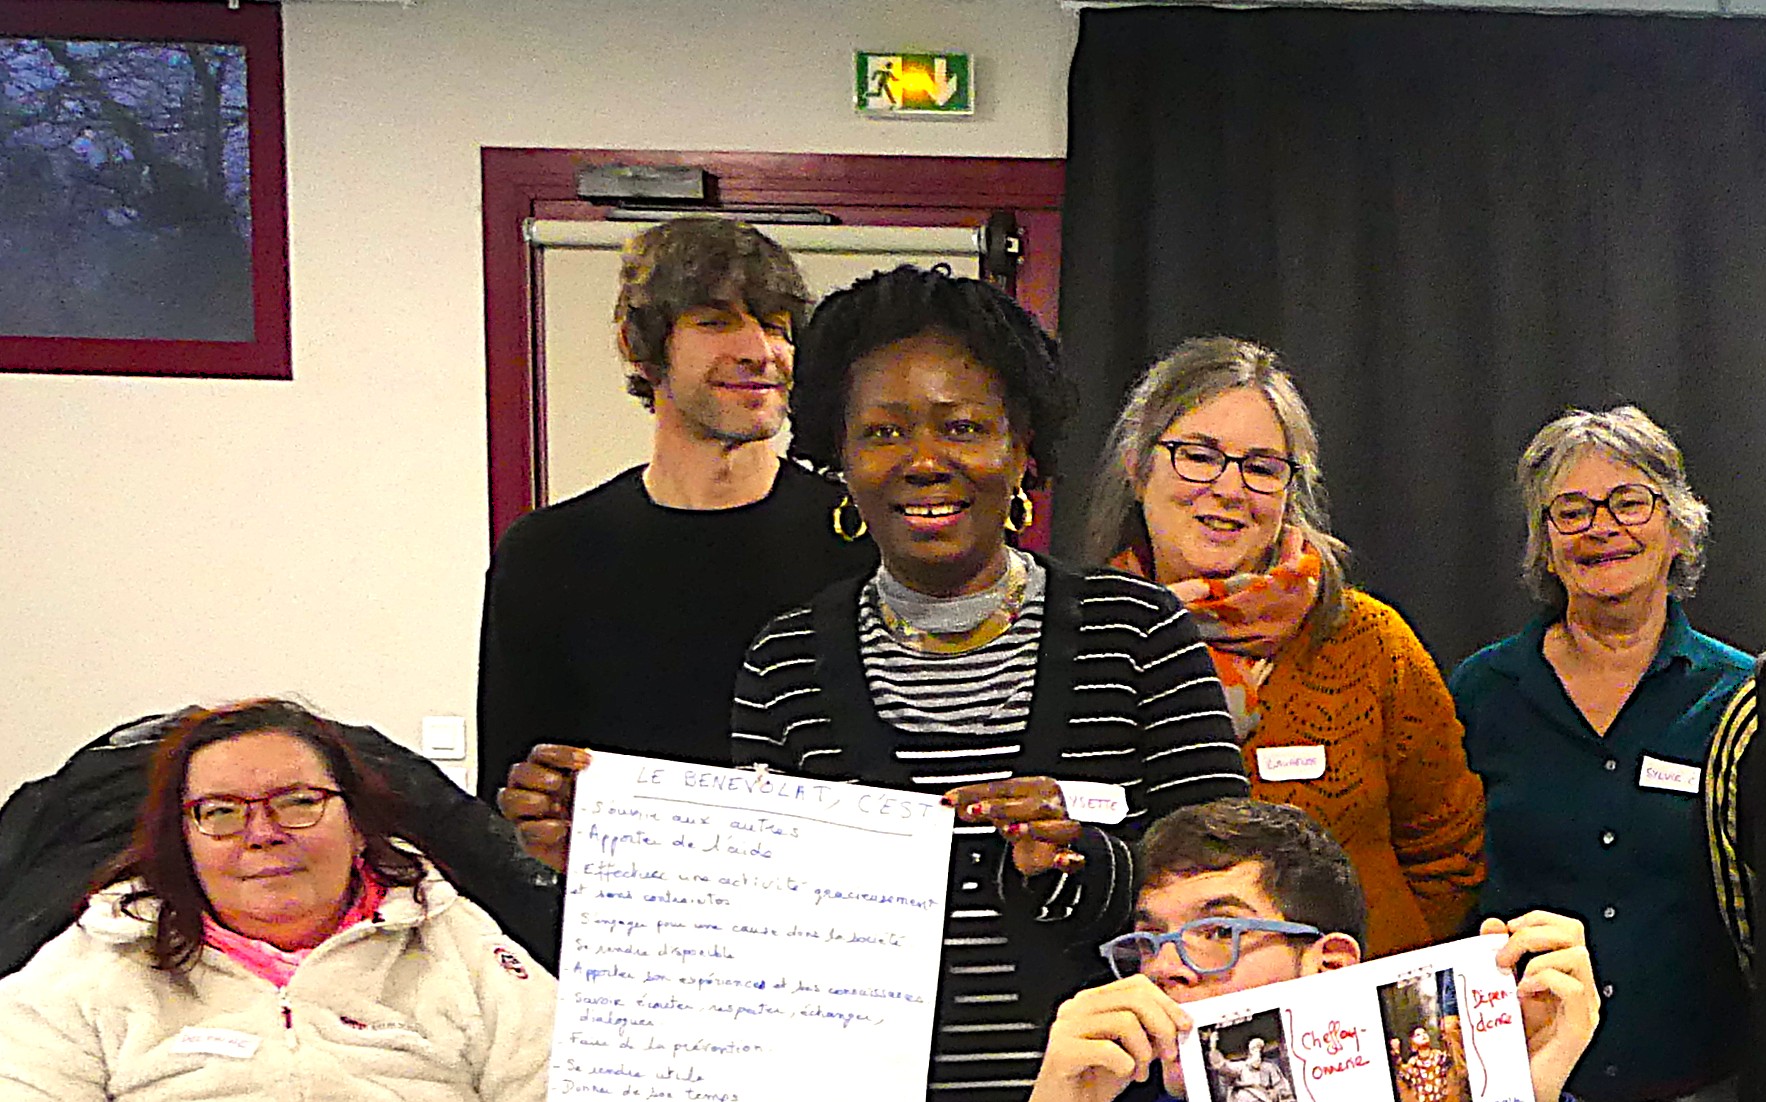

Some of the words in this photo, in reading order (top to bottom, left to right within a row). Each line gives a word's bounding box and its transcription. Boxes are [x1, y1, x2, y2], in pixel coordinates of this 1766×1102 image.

[636, 766, 665, 784] LE
[1068, 794, 1119, 812] YSETTE
[671, 814, 711, 826] aux
[671, 833, 697, 850] de
[772, 976, 788, 990] et
